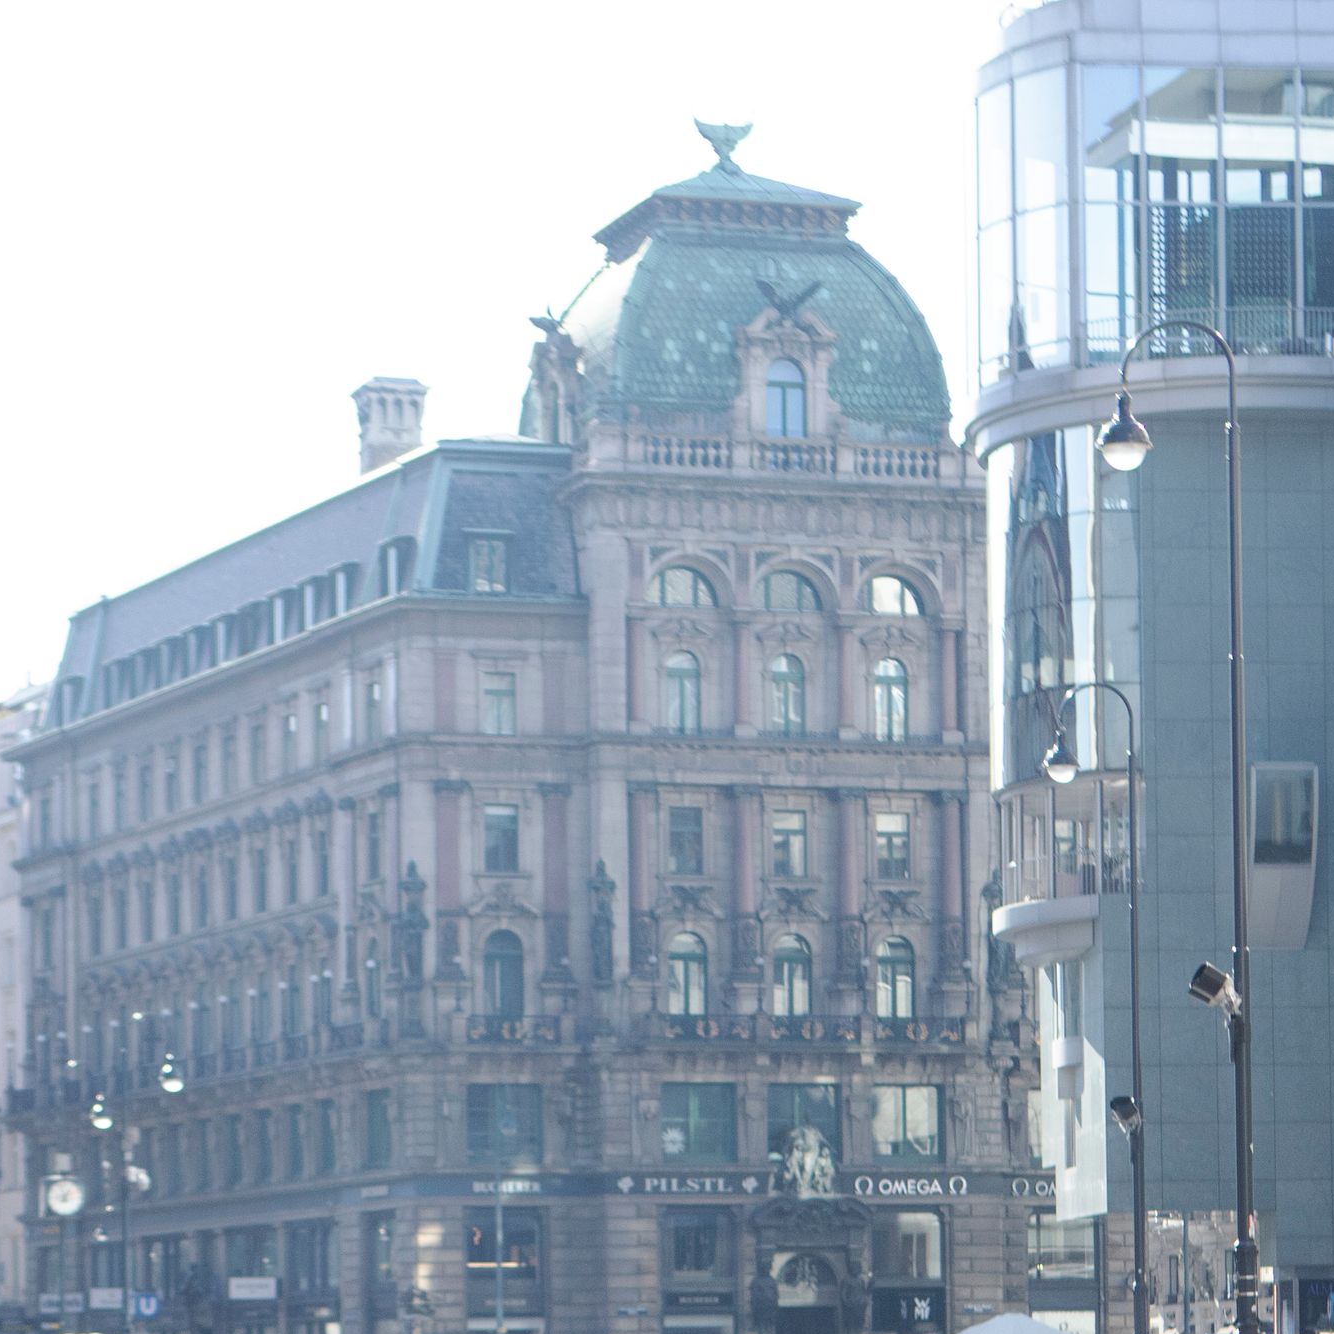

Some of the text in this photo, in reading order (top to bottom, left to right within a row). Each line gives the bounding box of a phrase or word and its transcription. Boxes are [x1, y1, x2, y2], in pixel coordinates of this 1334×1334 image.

[645, 1177, 733, 1193] PILSTL
[879, 1179, 943, 1195] OMEGA
[140, 1298, 157, 1315] U
